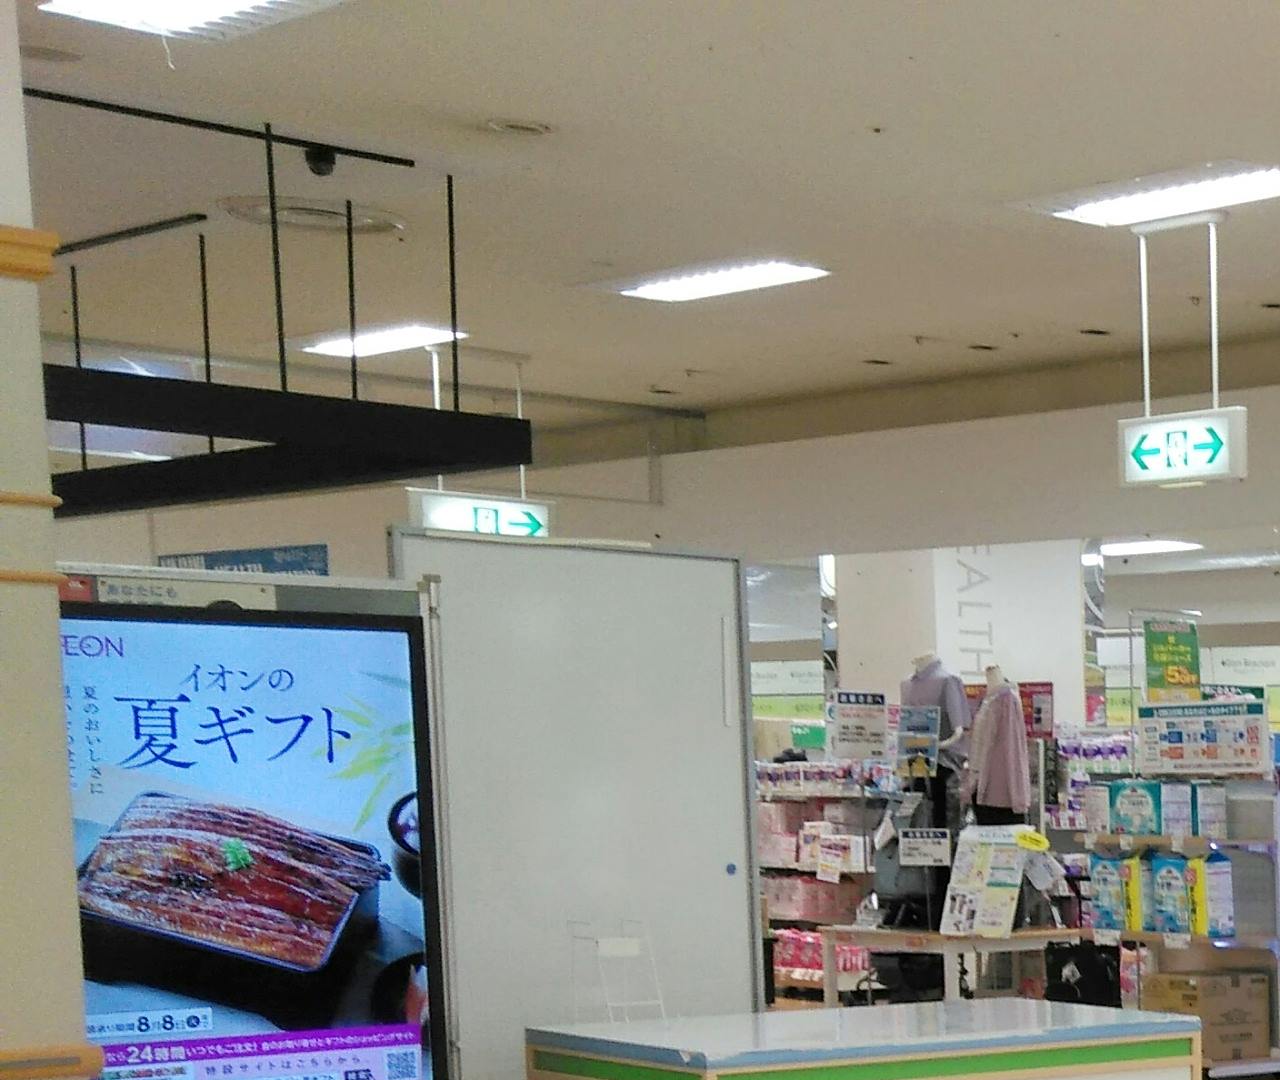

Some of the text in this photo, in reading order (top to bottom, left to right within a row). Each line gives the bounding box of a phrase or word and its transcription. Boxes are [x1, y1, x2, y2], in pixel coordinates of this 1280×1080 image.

[60, 634, 125, 658] EON
[178, 664, 294, 692] イオンの
[83, 685, 104, 795] 夏のおいしさに
[113, 693, 352, 769] 夏ギフト
